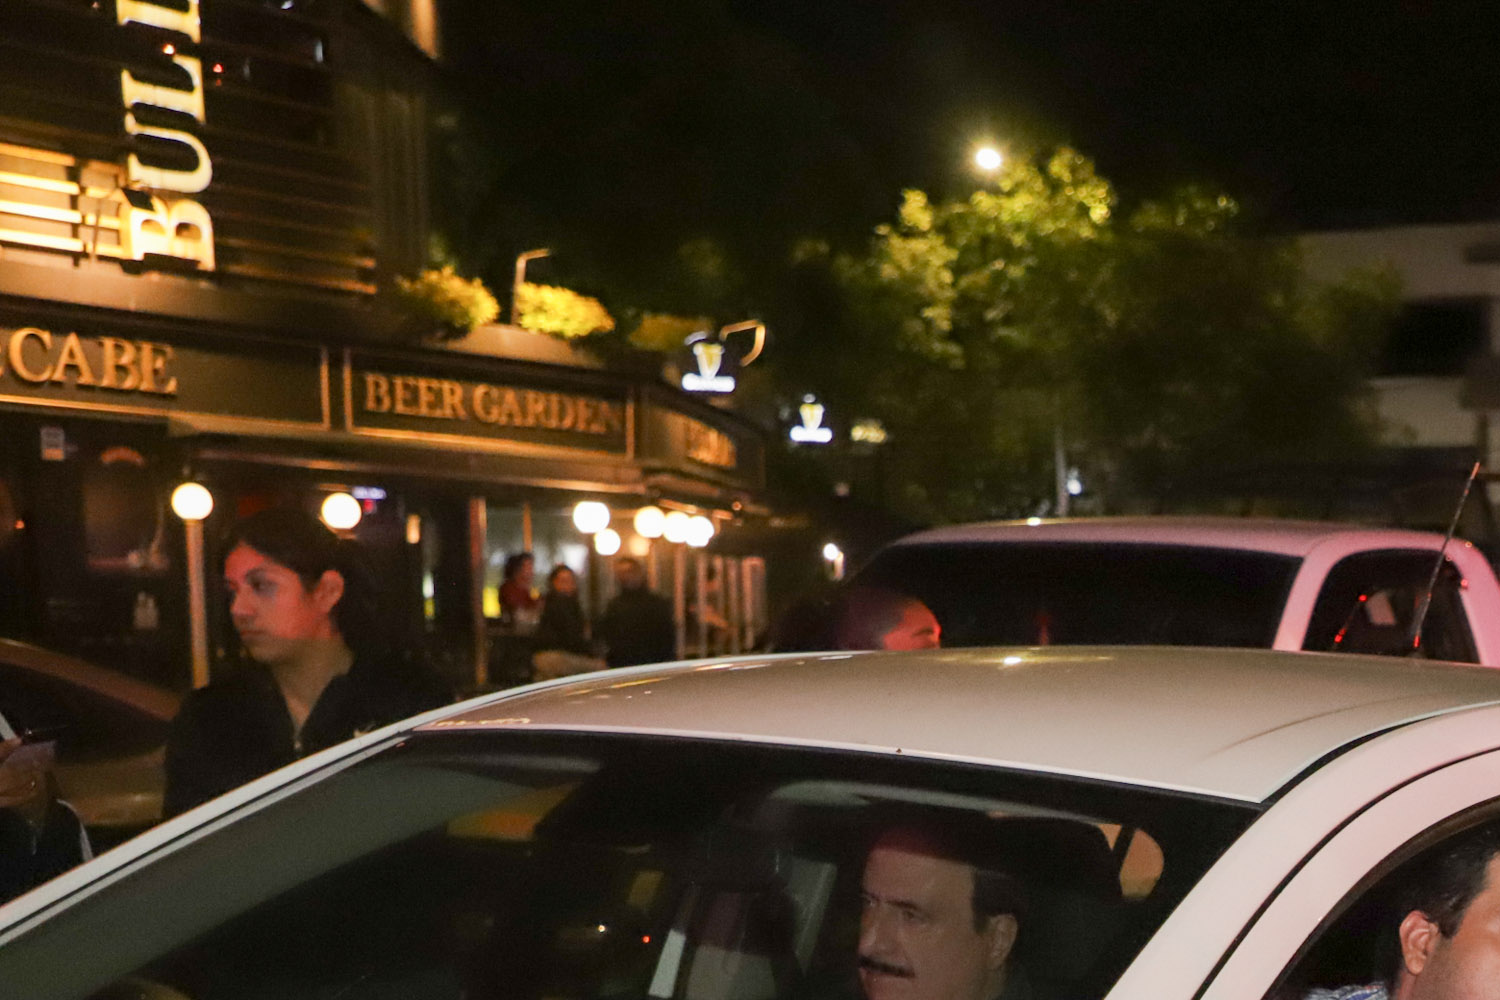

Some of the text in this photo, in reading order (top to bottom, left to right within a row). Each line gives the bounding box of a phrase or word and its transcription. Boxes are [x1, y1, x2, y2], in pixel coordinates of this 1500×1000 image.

[0, 327, 177, 395] CABE
[364, 373, 623, 434] BEER GARDEN
